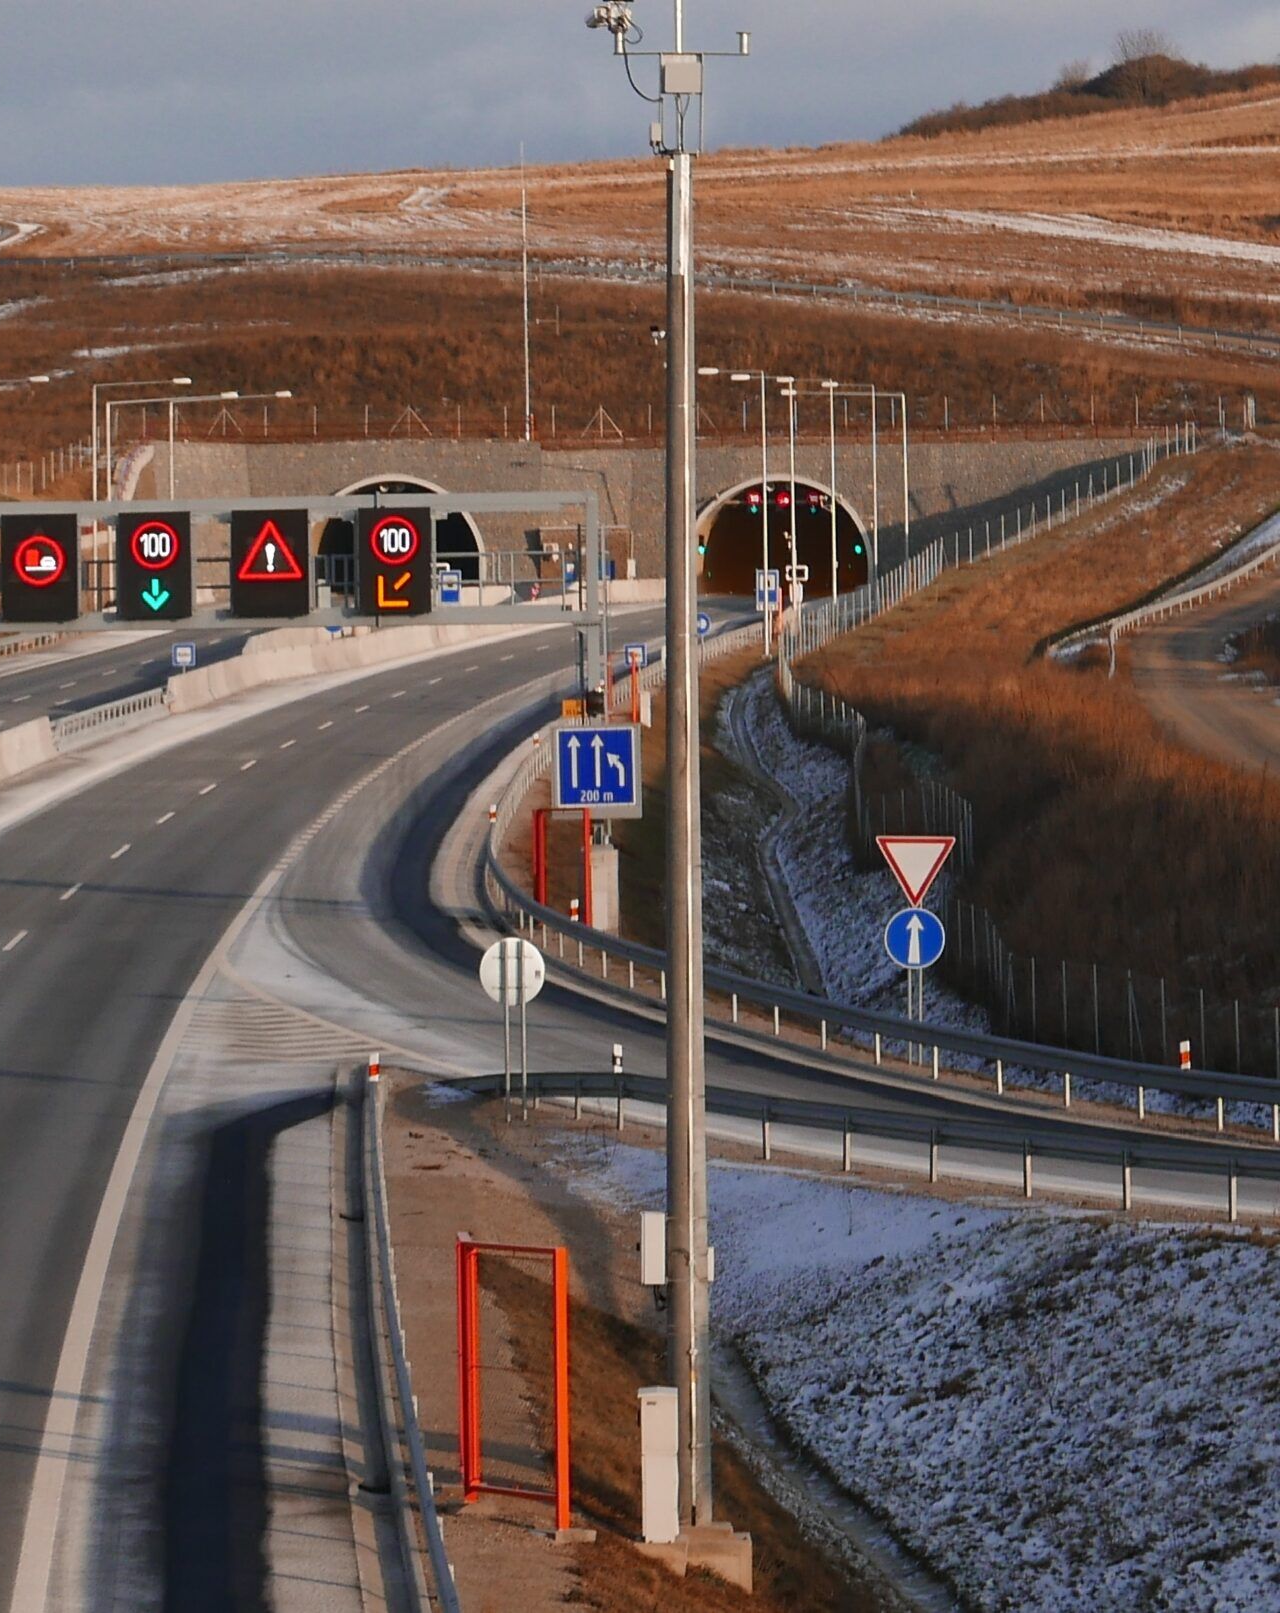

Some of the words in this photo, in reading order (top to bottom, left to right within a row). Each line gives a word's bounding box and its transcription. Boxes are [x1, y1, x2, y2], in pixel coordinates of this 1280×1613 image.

[140, 532, 170, 558] 100
[379, 528, 410, 553] 100
[580, 789, 600, 802] 200
[602, 791, 614, 802] m
